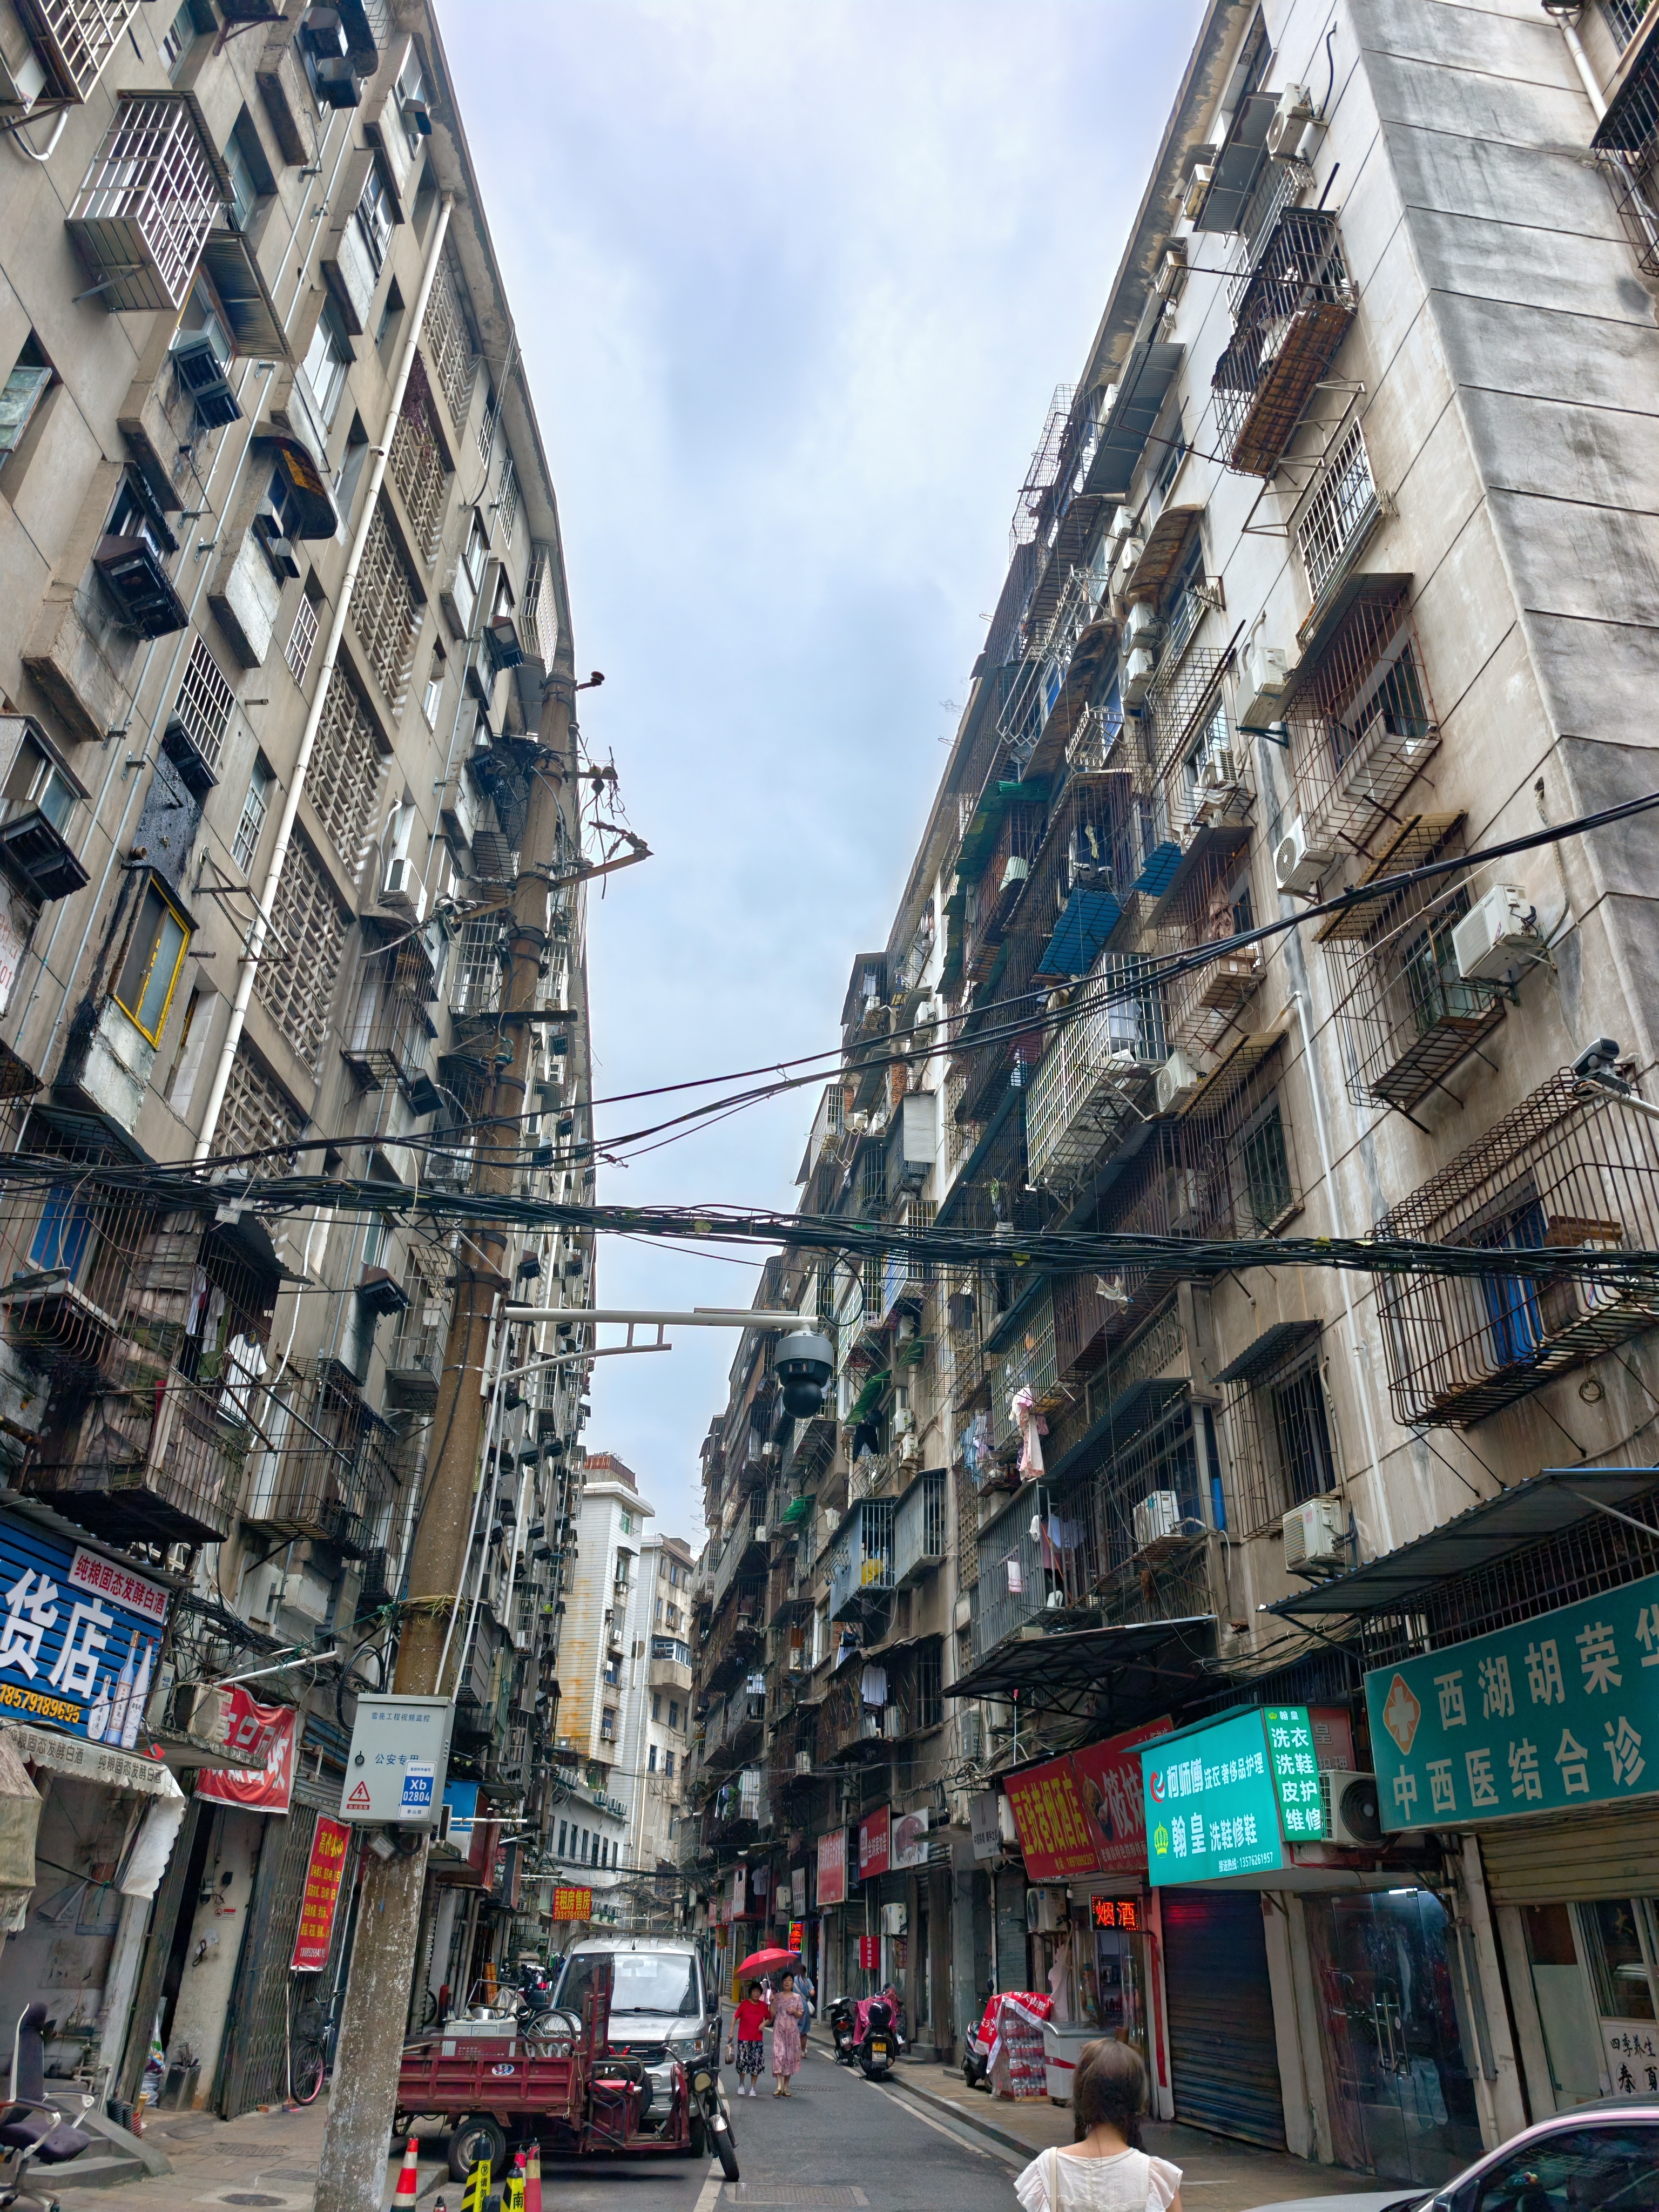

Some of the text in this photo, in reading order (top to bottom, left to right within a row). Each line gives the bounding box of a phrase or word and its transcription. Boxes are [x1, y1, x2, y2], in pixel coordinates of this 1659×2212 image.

[74, 1554, 166, 1616] 纯粮固态发酵白酒
[0, 1567, 113, 1699] 货店
[0, 1683, 82, 1724] 18579189695
[371, 1712, 430, 1723] 雪亮工程视频监控
[1279, 1710, 1299, 1721] 翰皇
[9, 1728, 84, 1765] 纯粮固态发酵白酒
[1271, 1727, 1310, 1748] 洗衣
[98, 1753, 163, 1784] 纯粮固态发酵白酒
[1166, 1752, 1264, 1799] 柯师傅 洗衣奢侈品护理
[1275, 1753, 1315, 1775] 洗鞋
[409, 1779, 427, 1790] Xb
[1282, 1780, 1318, 1803] 皮护
[403, 1791, 430, 1802] 02804
[1011, 1771, 1090, 1854] 豆豉巷烟酒店
[1285, 1808, 1321, 1831] 维修
[1171, 1812, 1258, 1858] 翰皇 洗鞋修鞋
[559, 1890, 590, 1910] 租房售房
[554, 1911, 590, 1920] 13317915552
[1096, 1900, 1135, 1927] 烟酒
[513, 2191, 524, 2210] 南
